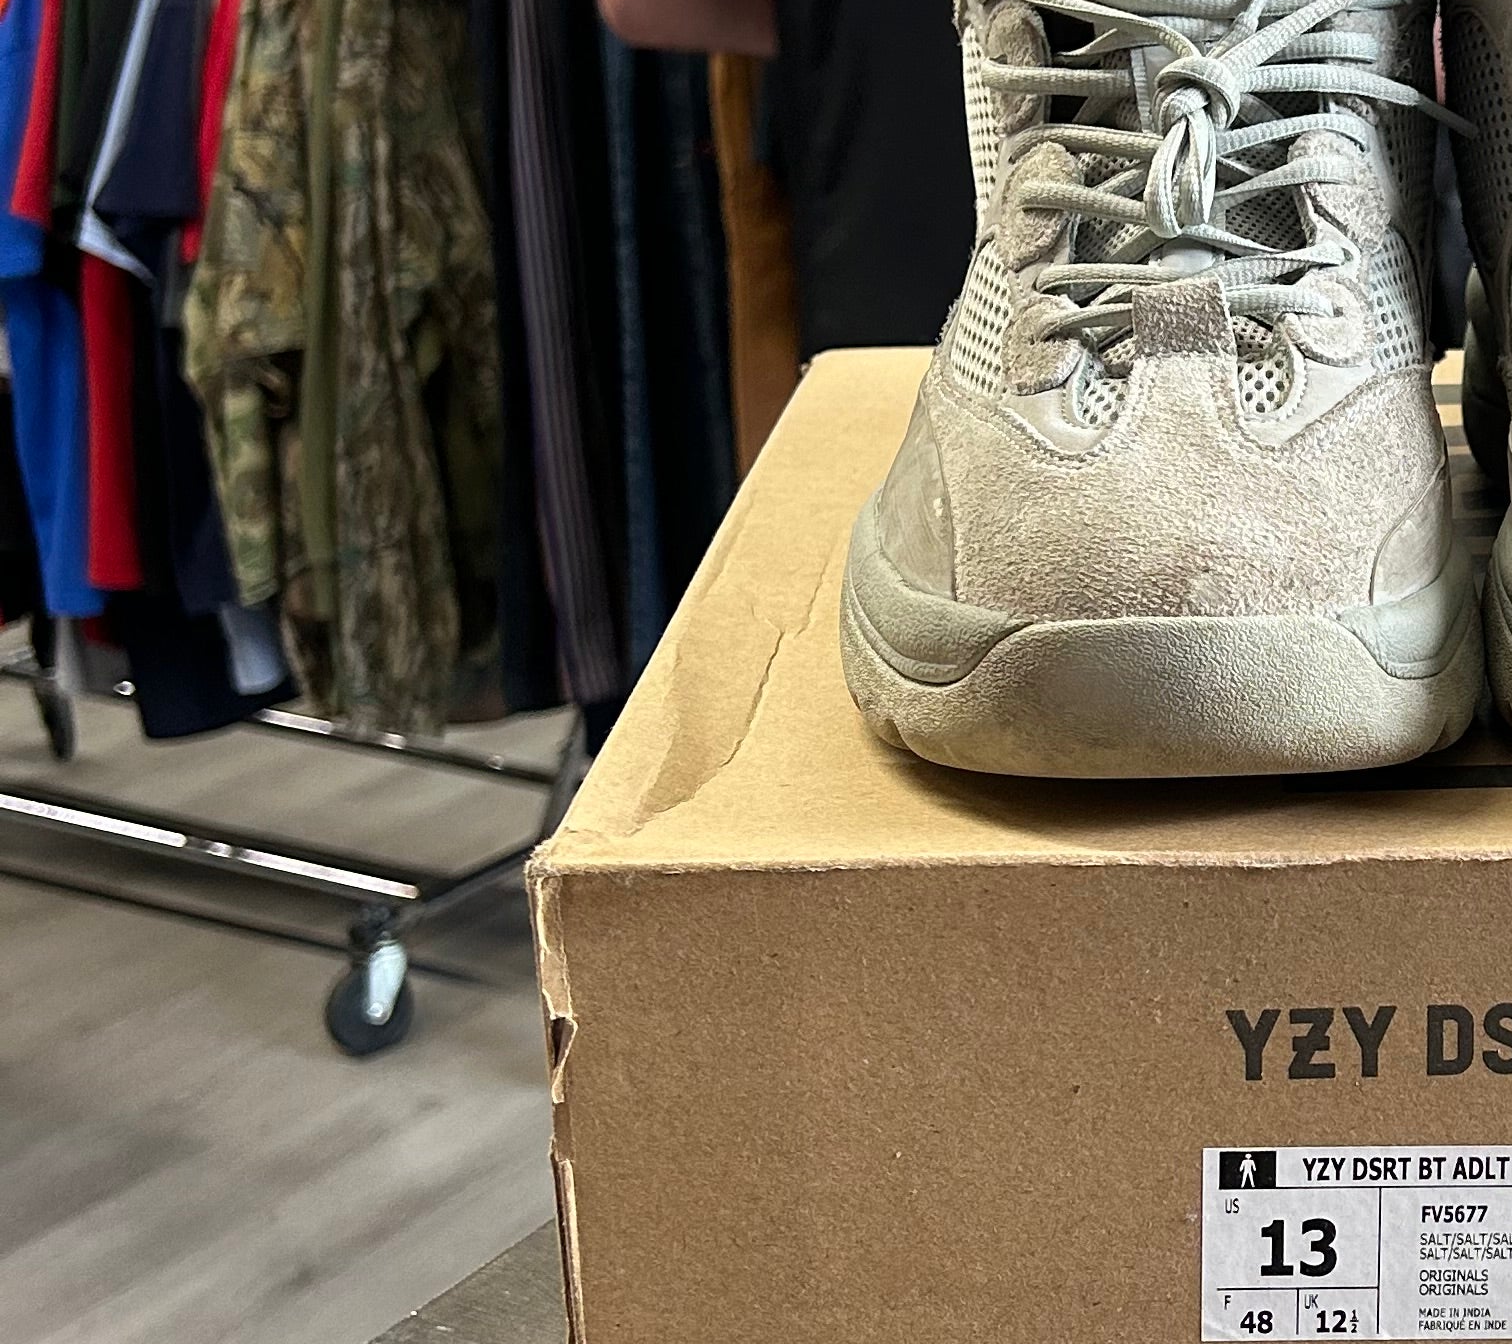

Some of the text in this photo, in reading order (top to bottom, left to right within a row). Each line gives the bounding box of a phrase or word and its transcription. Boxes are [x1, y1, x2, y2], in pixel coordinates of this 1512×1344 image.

[1302, 1156, 1510, 1181] YZY DSRT BT ADLT
[1224, 1197, 1240, 1214] US
[1421, 1205, 1489, 1223] FV5677
[1260, 1218, 1338, 1277] 13
[1419, 1269, 1489, 1282] ORIGINALS
[1419, 1283, 1489, 1296] ORIGINALS
[1223, 1295, 1231, 1310] F
[1304, 1294, 1319, 1309] UK
[1418, 1307, 1491, 1318] MADE IN INDIA
[1240, 1310, 1273, 1334] 48
[1418, 1318, 1507, 1332] FABRIQUÉ EN INDE
